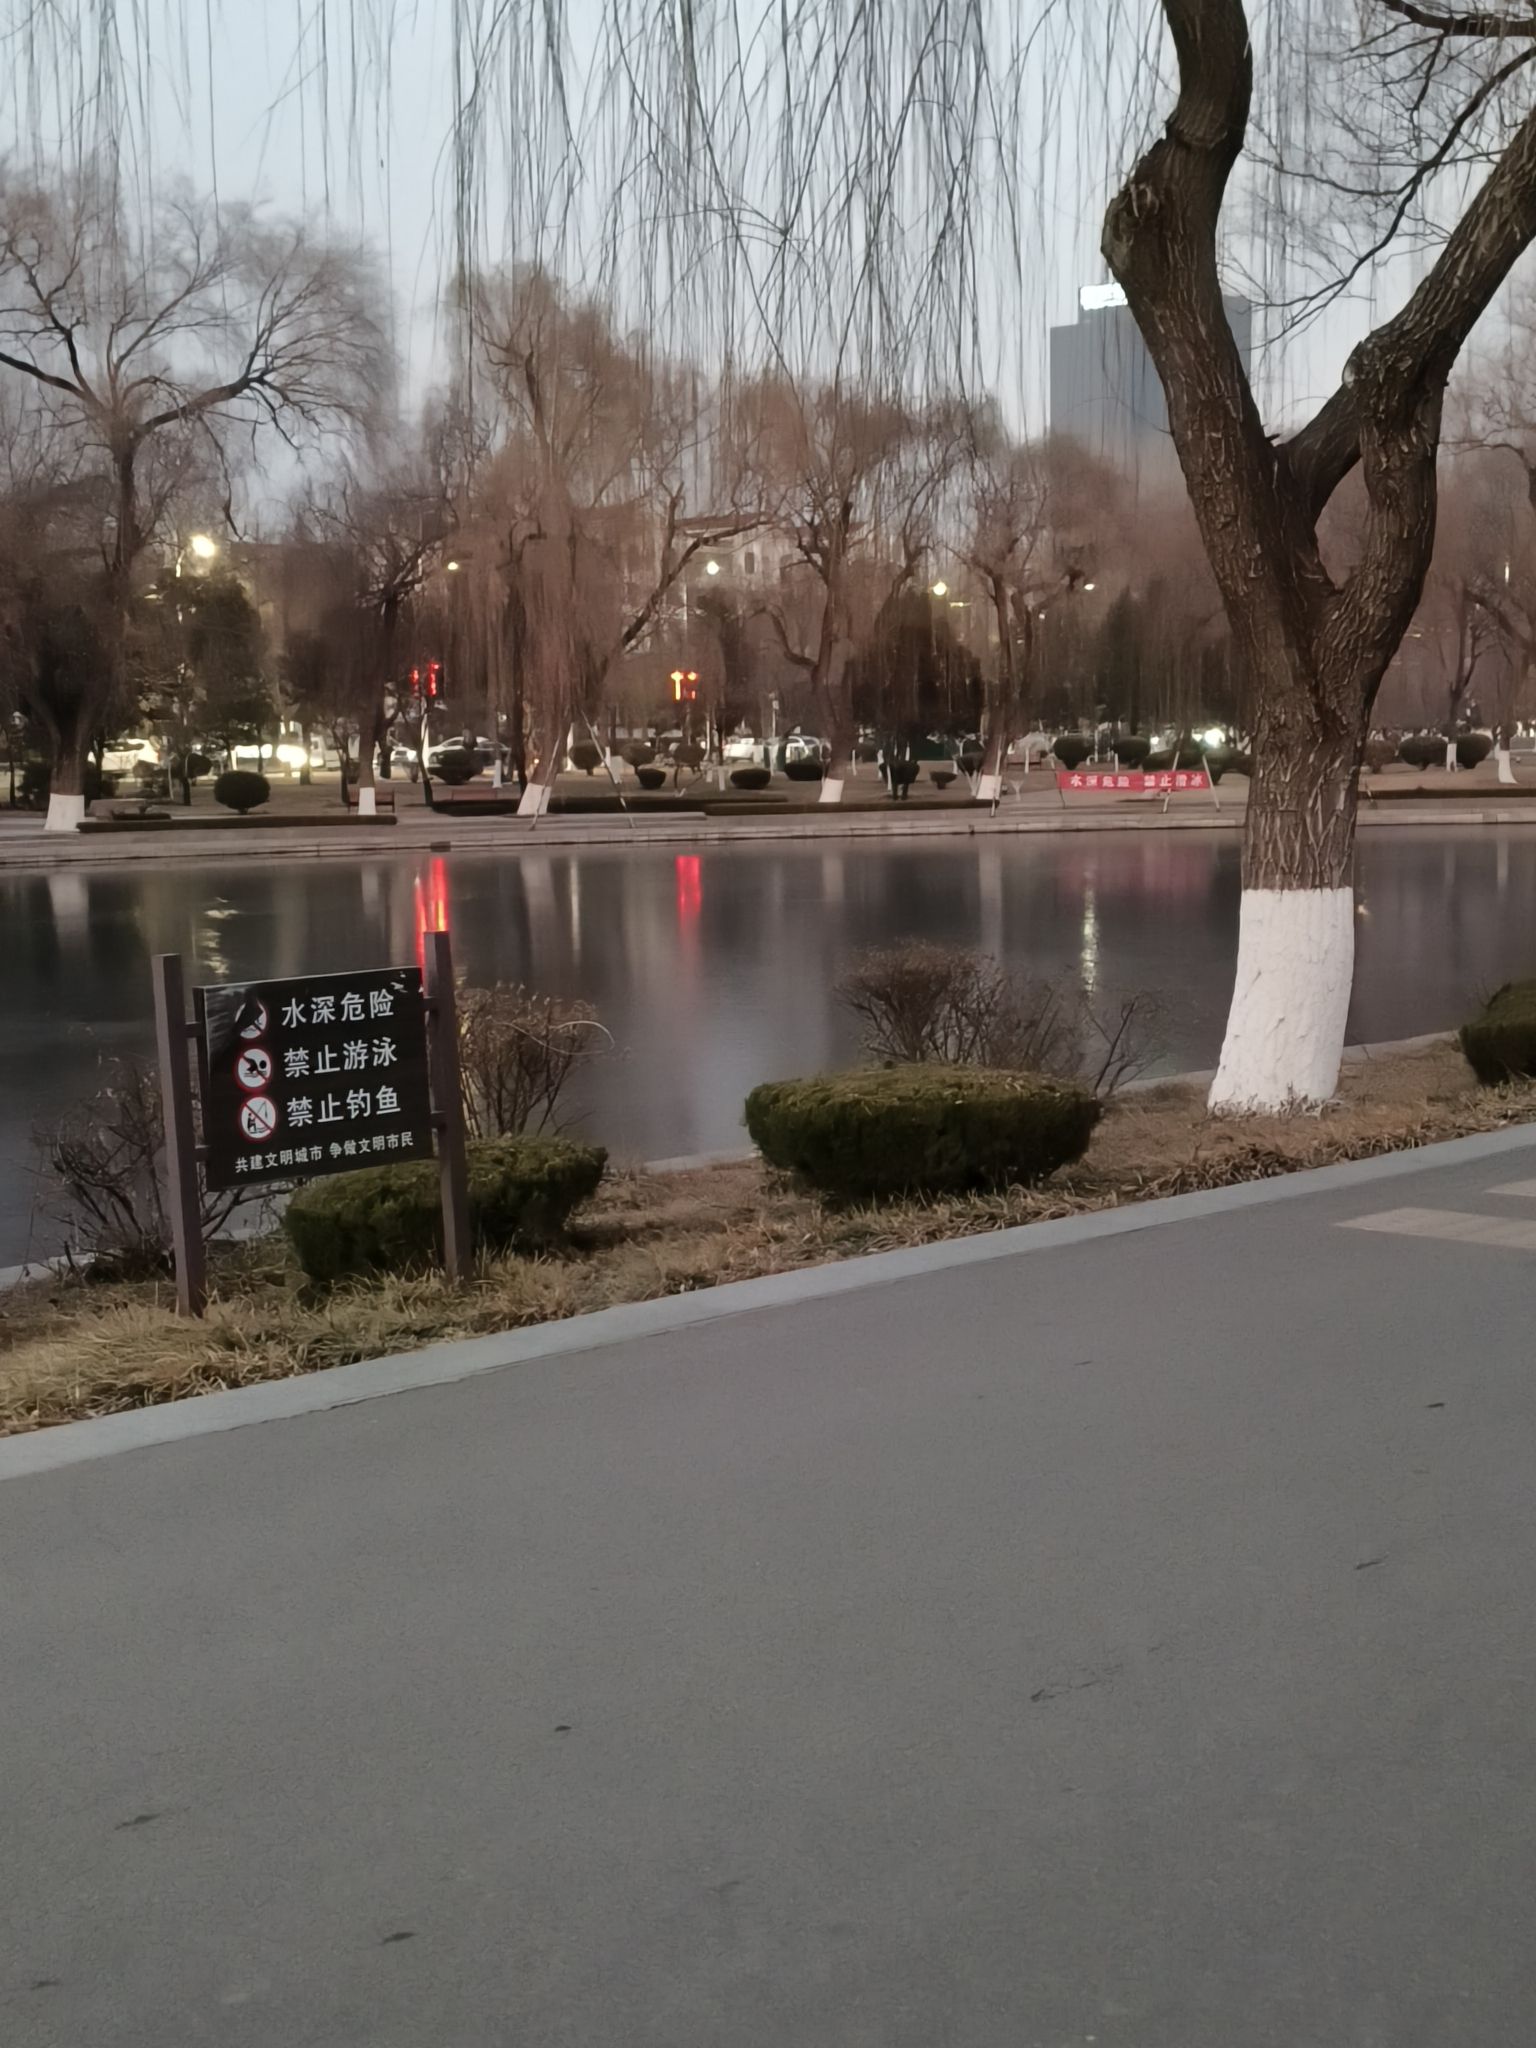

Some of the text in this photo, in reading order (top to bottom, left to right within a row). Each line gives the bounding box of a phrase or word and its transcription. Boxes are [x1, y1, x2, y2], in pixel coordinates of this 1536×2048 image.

[281, 988, 395, 1029] 水深危险
[284, 1036, 398, 1079] 禁止游泳
[286, 1084, 401, 1128] 禁止钓鱼
[234, 1131, 414, 1173] 共建文明城市 争做文明市民
